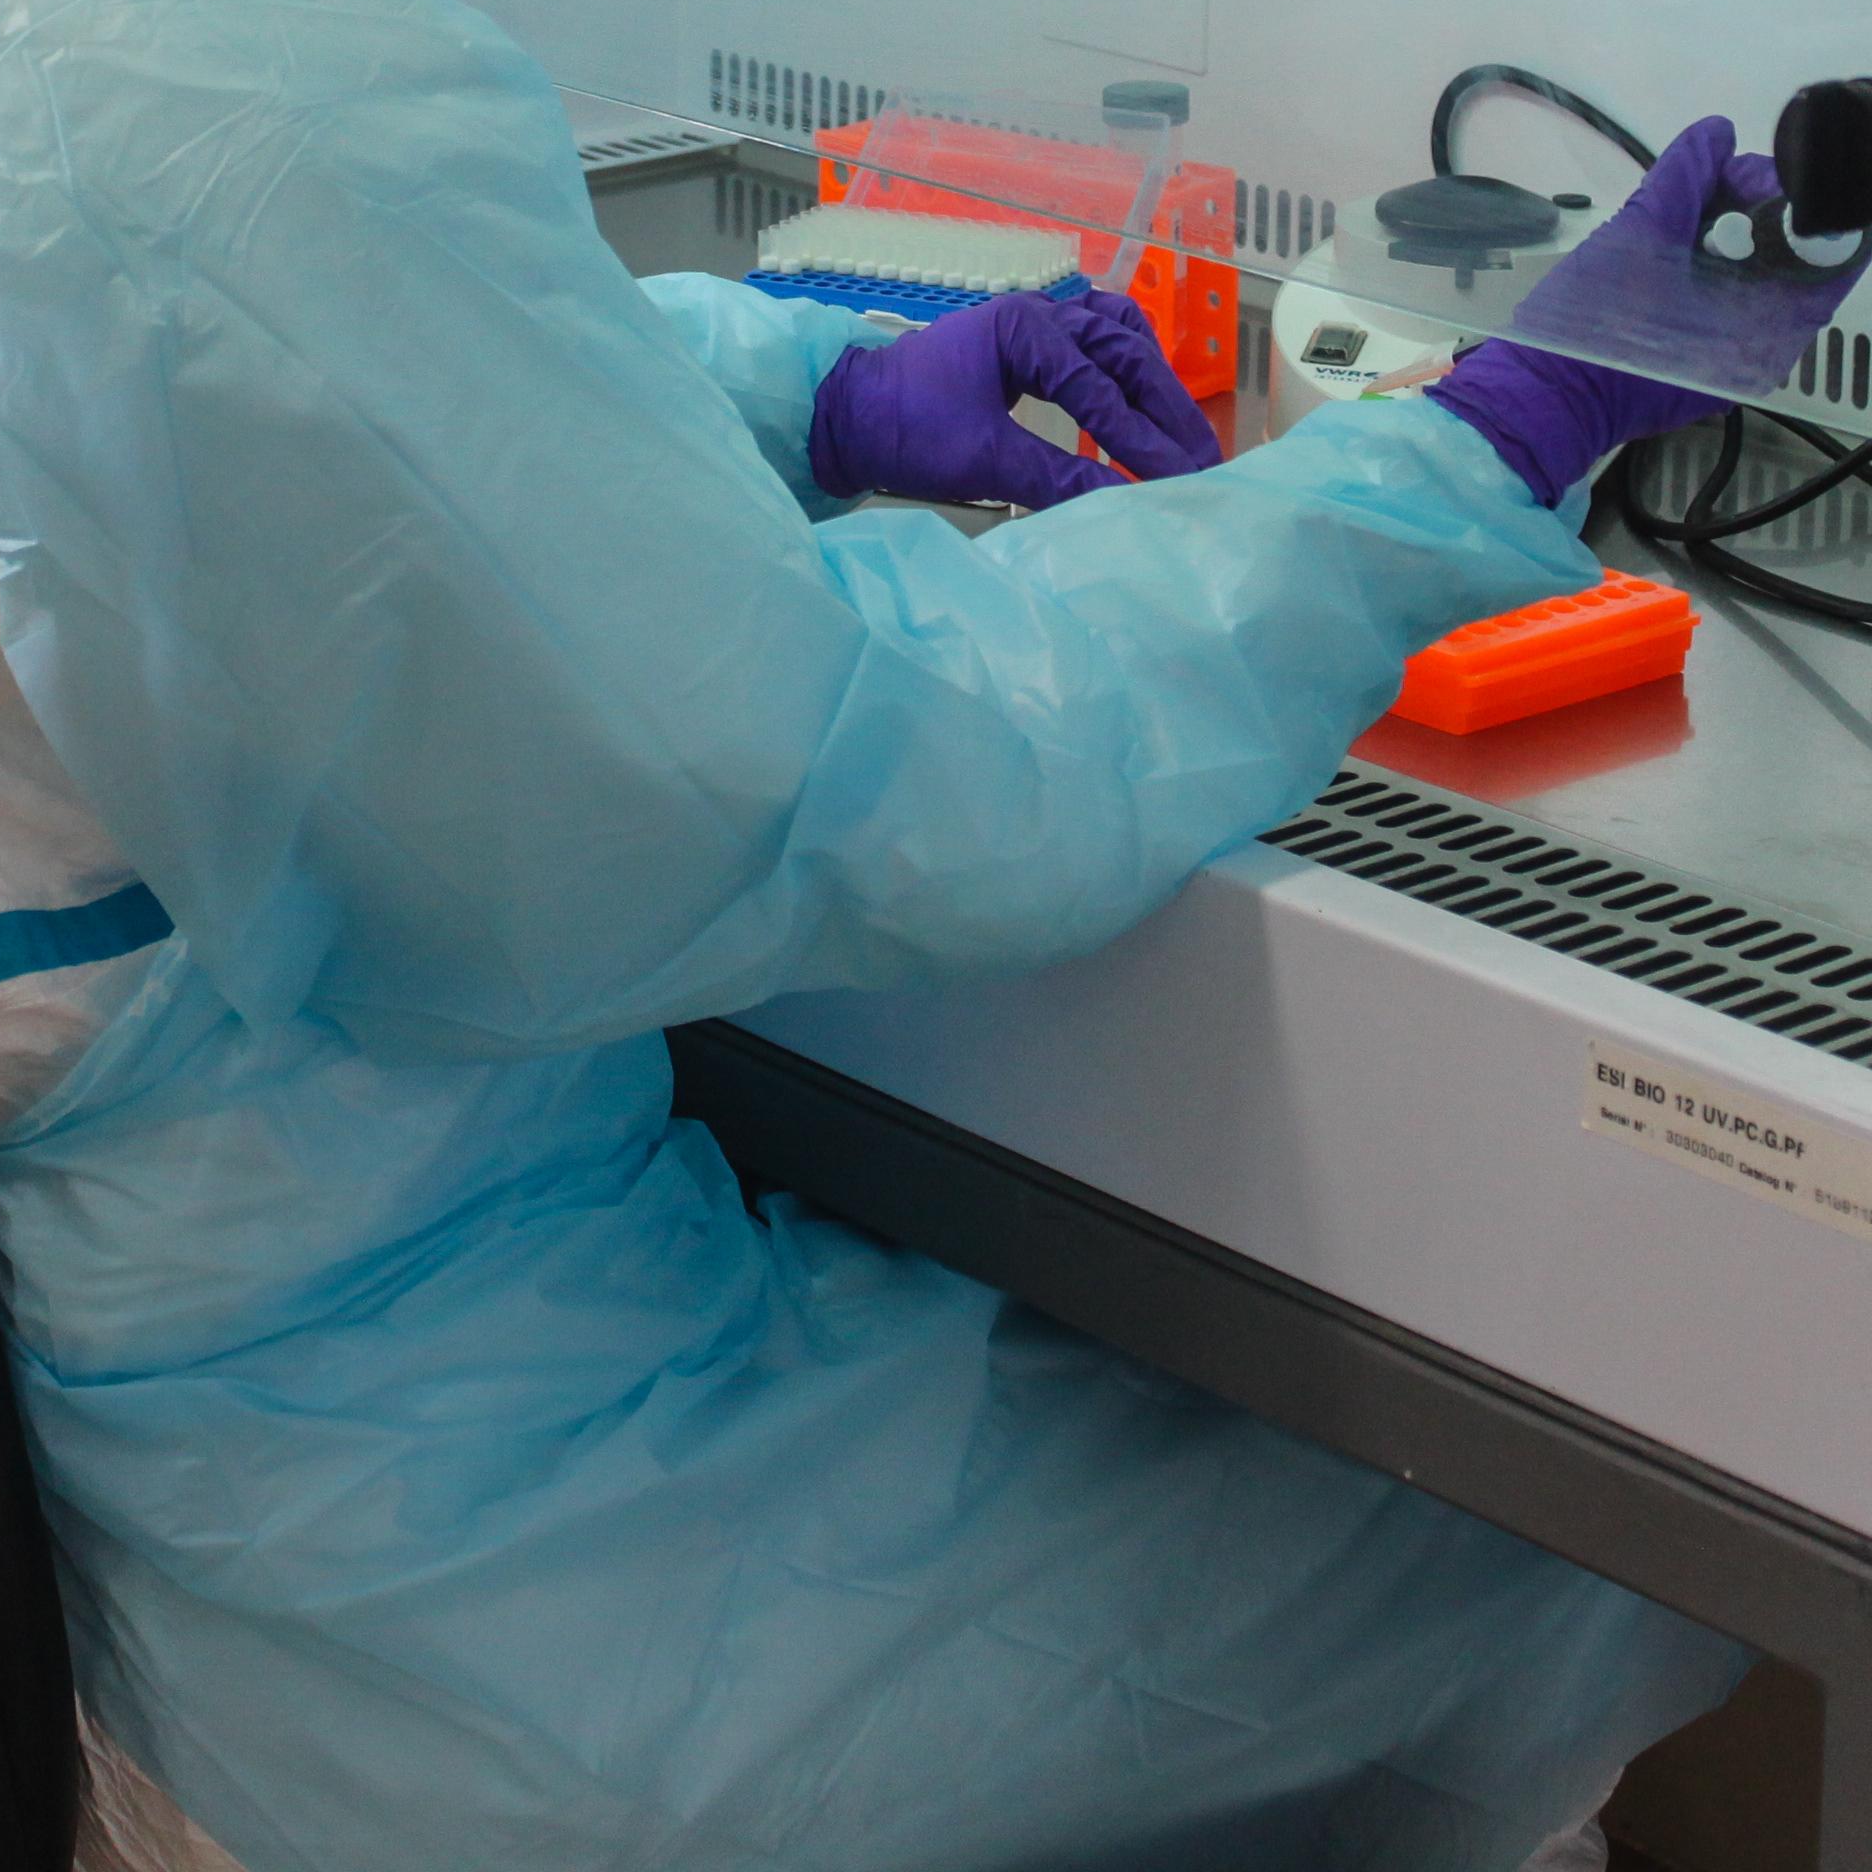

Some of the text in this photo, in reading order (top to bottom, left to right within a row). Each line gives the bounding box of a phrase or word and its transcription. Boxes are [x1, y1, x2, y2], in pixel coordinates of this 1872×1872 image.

[1316, 367, 1361, 377] VWR
[1597, 1062, 1626, 1090] ESI
[1634, 1077, 1665, 1105] BIO
[1675, 1094, 1695, 1117] 12
[1600, 1106, 1630, 1127] Serial
[1739, 1161, 1781, 1191] Catalog
